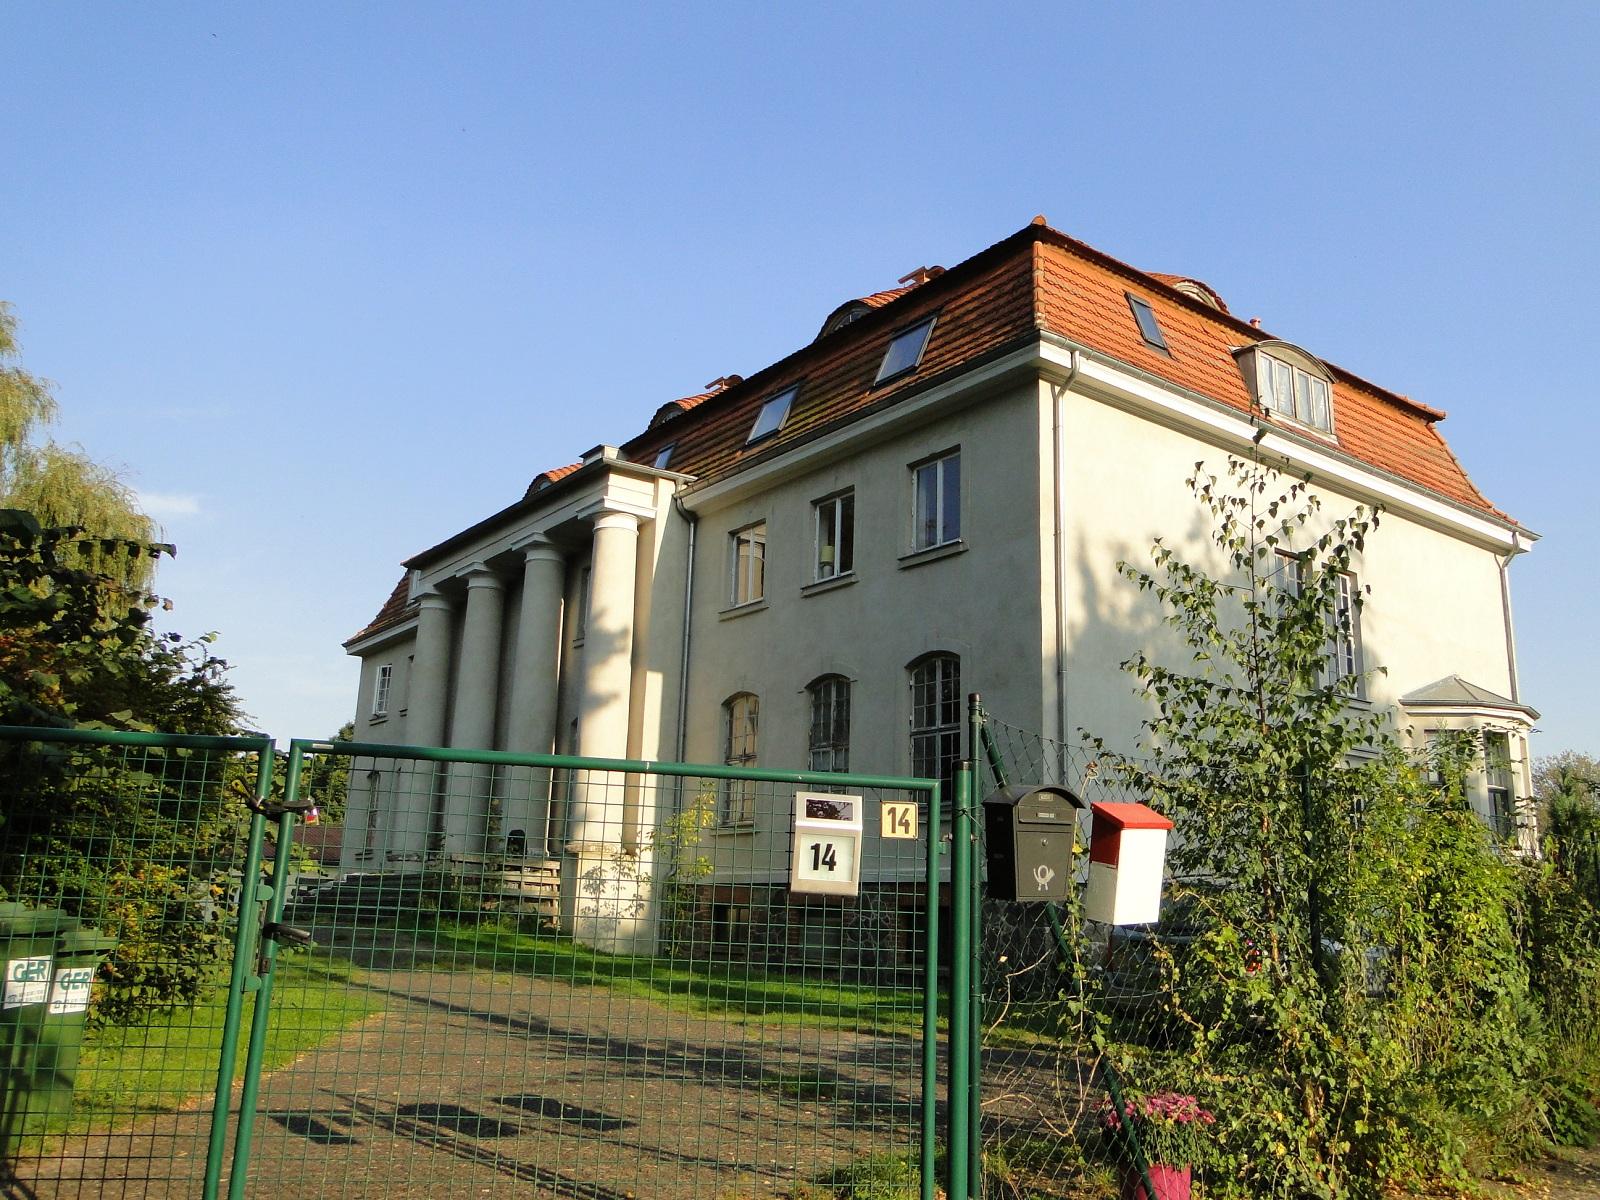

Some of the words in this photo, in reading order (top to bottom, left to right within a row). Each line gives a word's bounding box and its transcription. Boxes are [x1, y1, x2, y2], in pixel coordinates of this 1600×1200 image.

[887, 807, 911, 834] 14
[810, 843, 837, 871] 14
[14, 961, 47, 982] GER
[60, 972, 91, 990] GER
